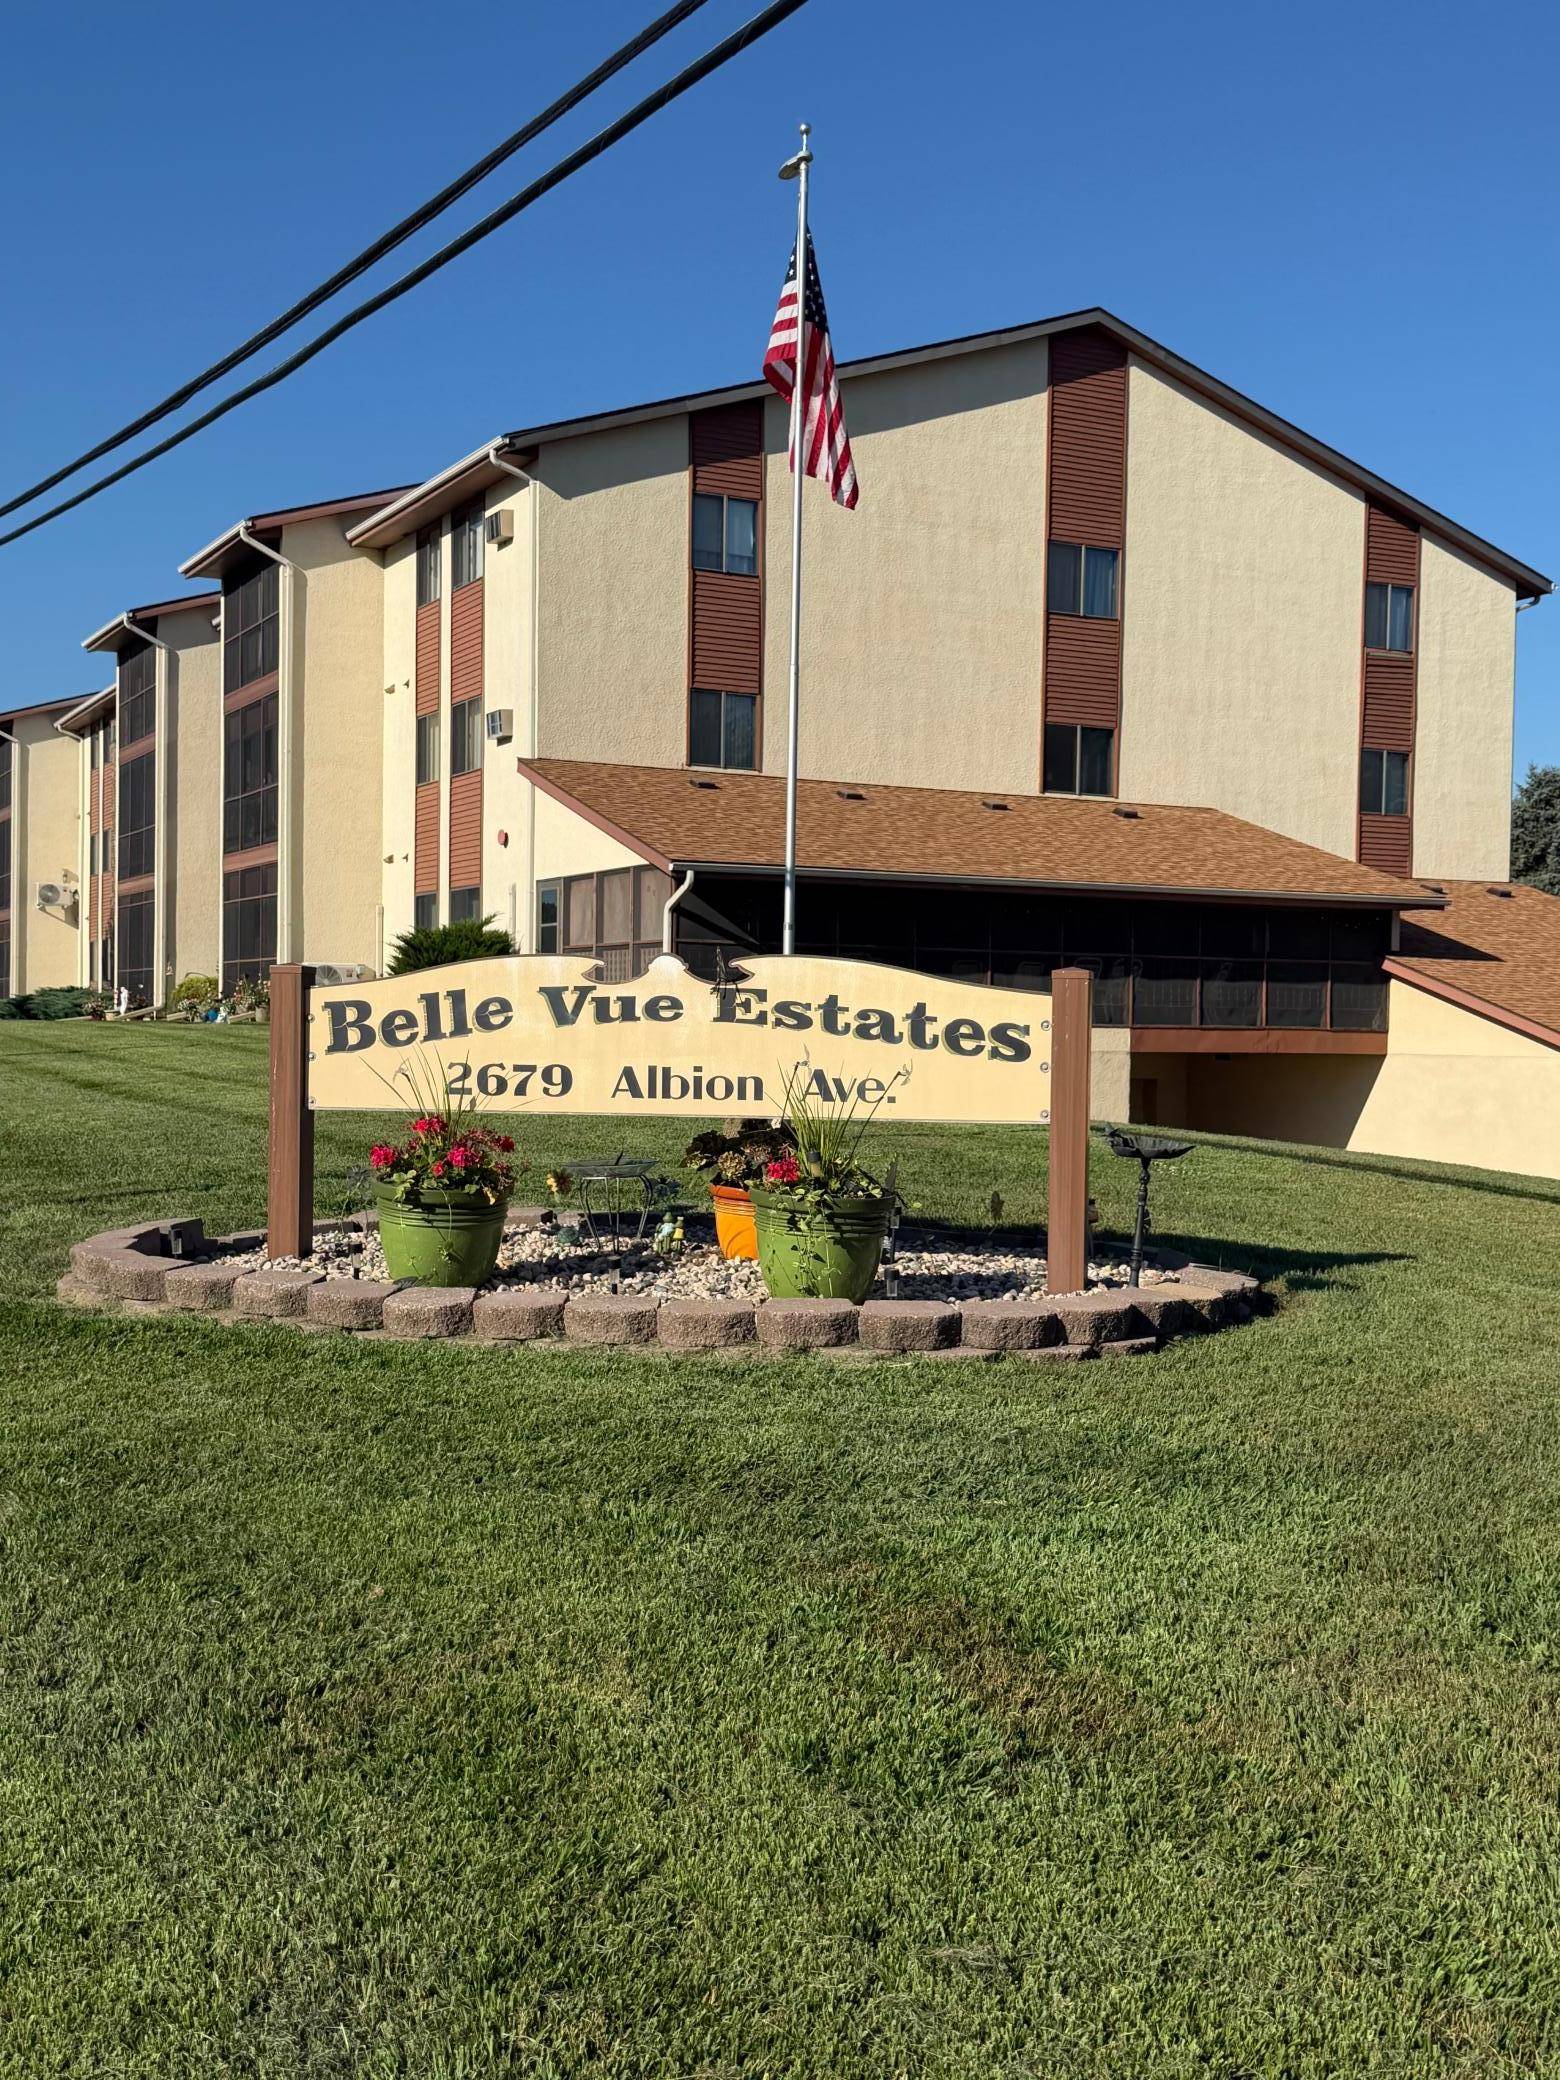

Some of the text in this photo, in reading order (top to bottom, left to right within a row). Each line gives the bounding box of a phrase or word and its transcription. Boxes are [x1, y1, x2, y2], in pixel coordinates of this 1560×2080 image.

[323, 985, 1032, 1063] Belle Vue Estates
[447, 1062, 897, 1104] 2679 Albion Ave.
